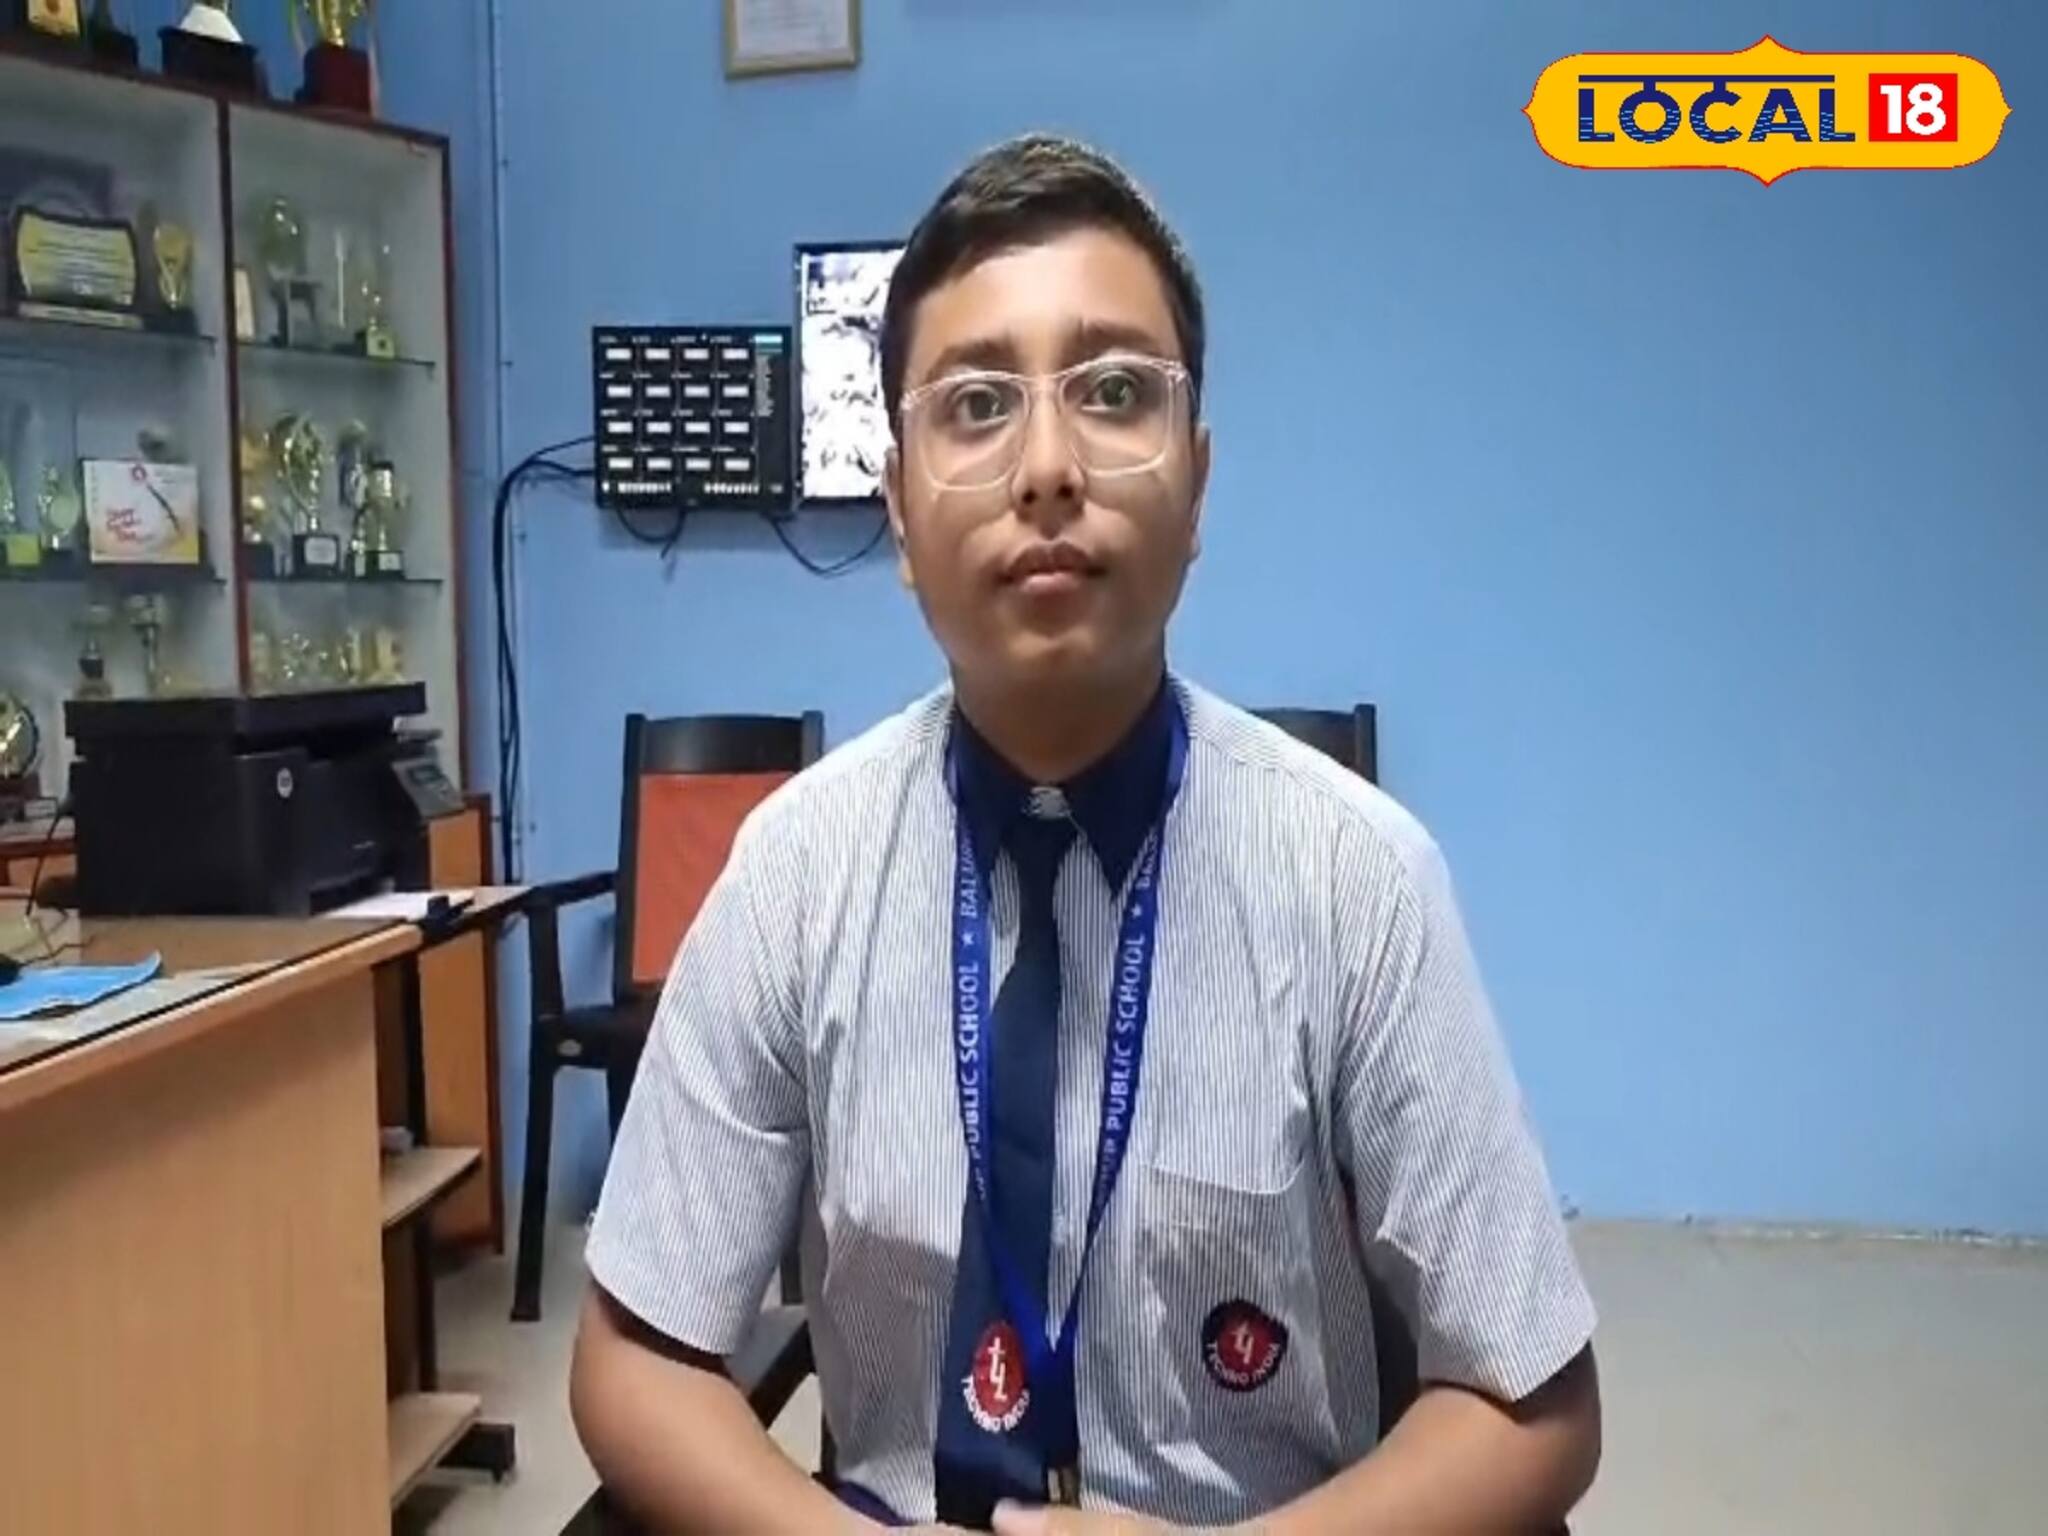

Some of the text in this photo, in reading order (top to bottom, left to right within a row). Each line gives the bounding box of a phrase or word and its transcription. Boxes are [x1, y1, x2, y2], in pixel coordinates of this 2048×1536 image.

[958, 960, 979, 1063] SCHOOL
[1116, 933, 1146, 1034] SCHOOL
[1106, 1043, 1137, 1131] PUBLIC
